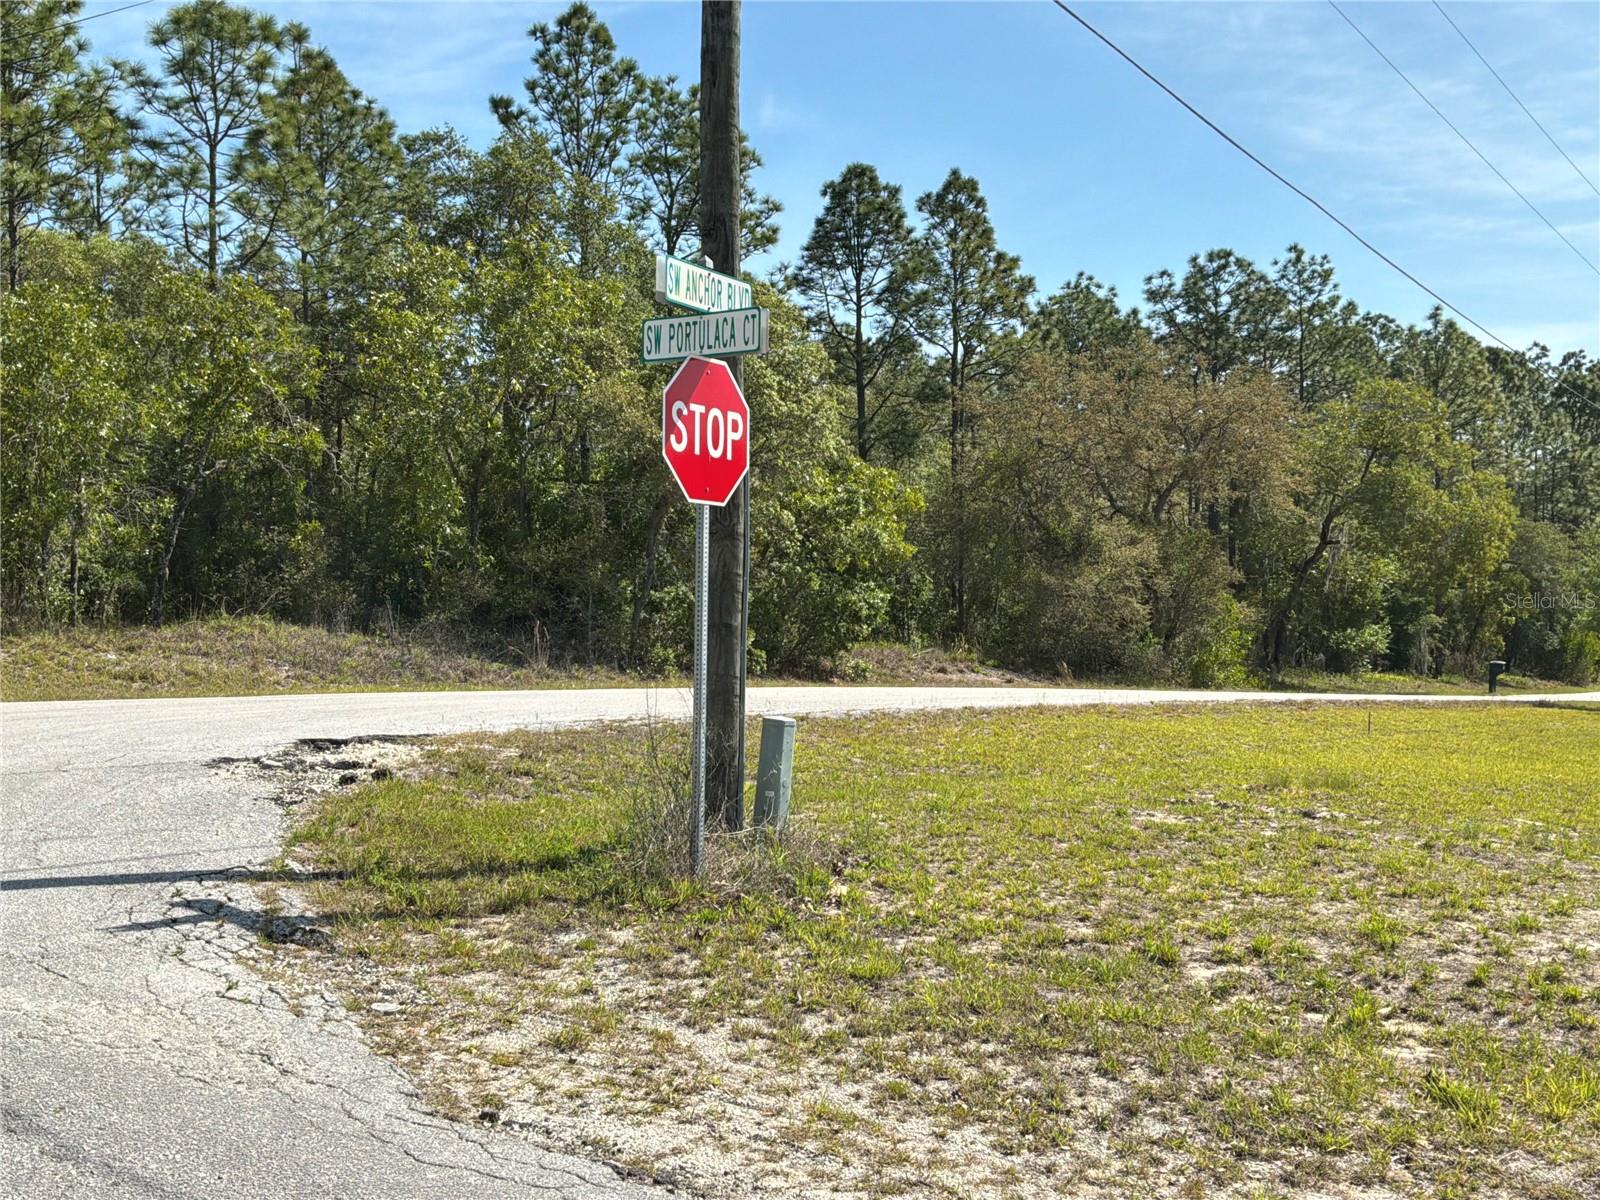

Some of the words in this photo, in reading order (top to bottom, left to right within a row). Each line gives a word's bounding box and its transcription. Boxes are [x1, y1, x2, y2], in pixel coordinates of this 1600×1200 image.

[667, 262, 681, 295] SW
[685, 270, 722, 309] ANCHOR
[646, 324, 662, 355] SW
[668, 317, 736, 353] PORTULACA
[743, 314, 757, 346] CT
[670, 401, 743, 460] STOP
